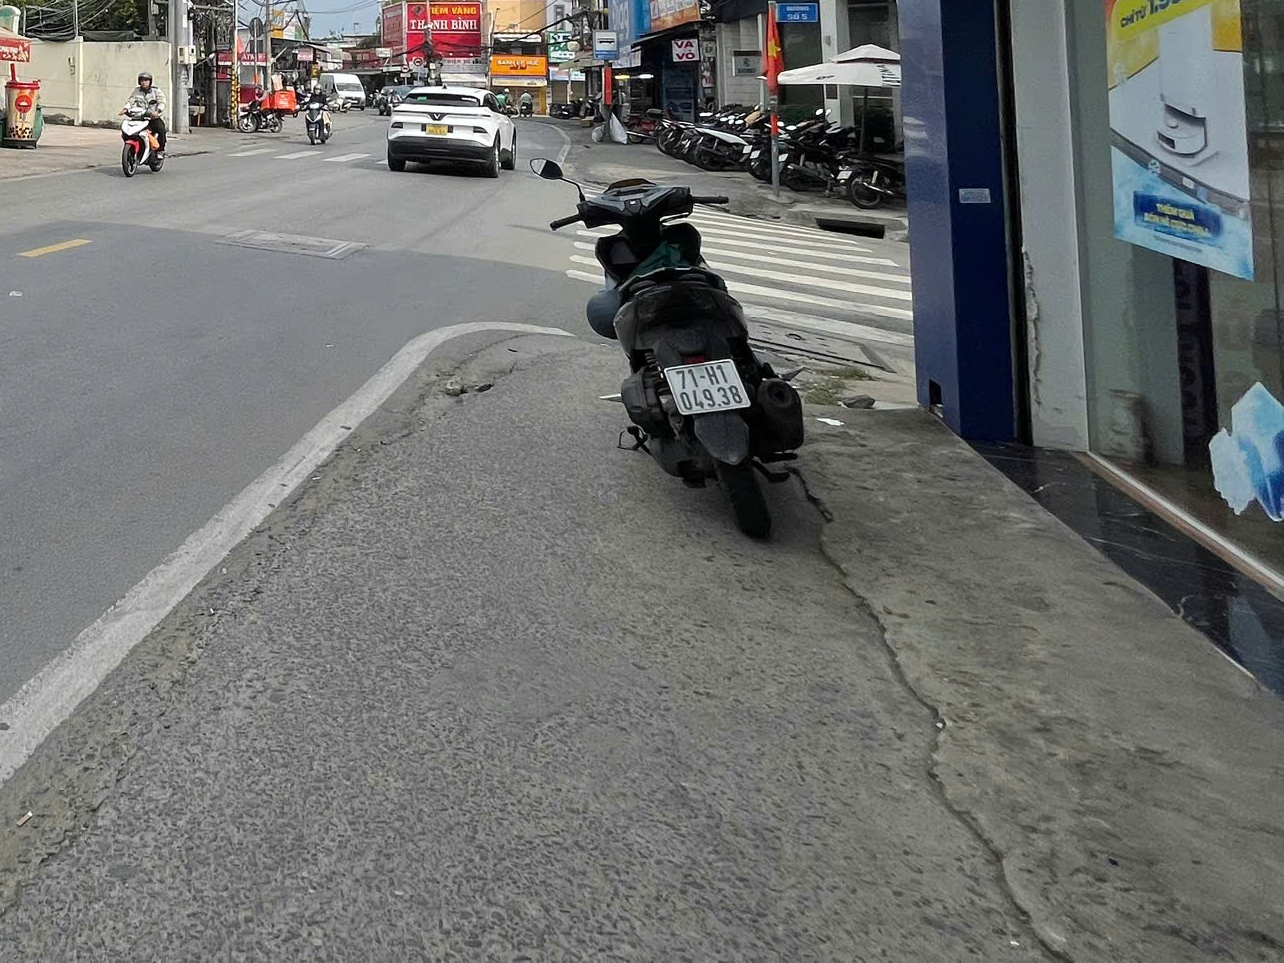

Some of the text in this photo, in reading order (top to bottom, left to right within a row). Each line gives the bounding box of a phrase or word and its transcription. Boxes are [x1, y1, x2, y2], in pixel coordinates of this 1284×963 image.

[452, 6, 476, 15] VÀNG
[451, 16, 477, 30] BÌNH
[676, 365, 728, 390] 71-H1
[680, 385, 743, 411] 049.38
